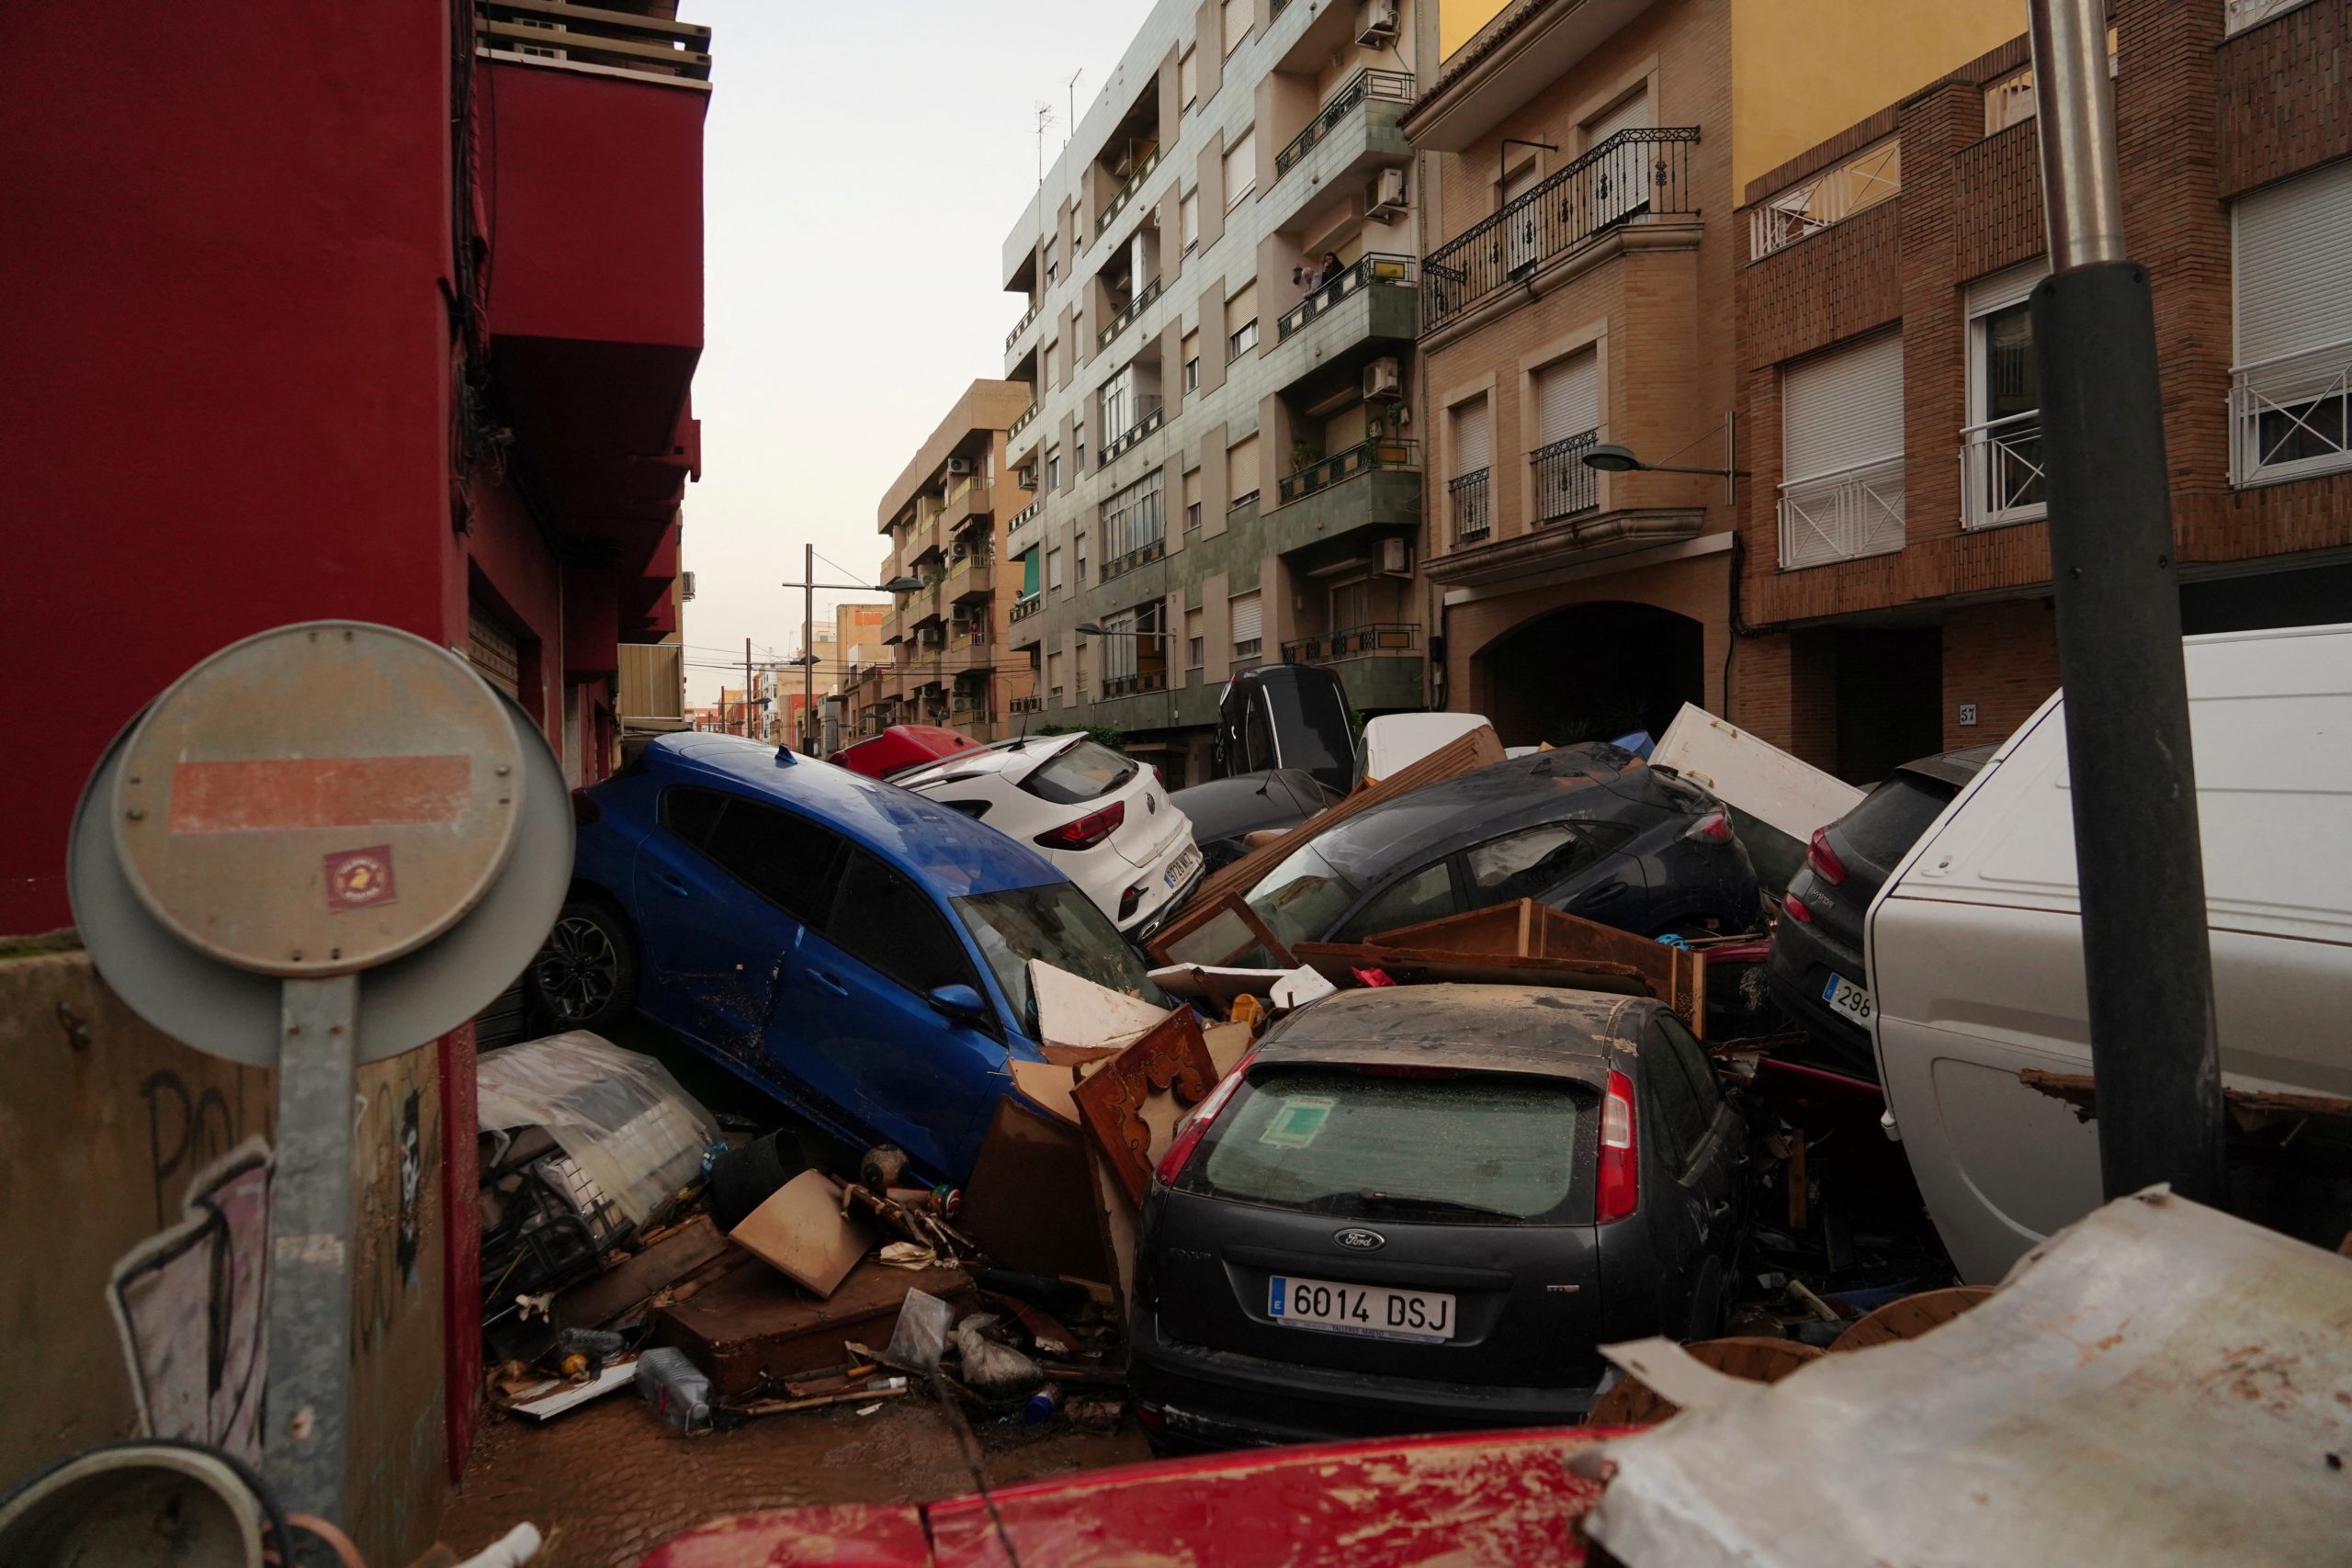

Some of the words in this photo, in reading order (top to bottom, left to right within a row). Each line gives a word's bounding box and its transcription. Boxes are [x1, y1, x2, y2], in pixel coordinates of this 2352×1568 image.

[1961, 707, 1974, 722] 57
[1167, 862, 1184, 882] 9728
[1273, 1300, 1282, 1310] E
[1294, 1284, 1370, 1323] 6014
[1386, 1294, 1448, 1331] DSJ
